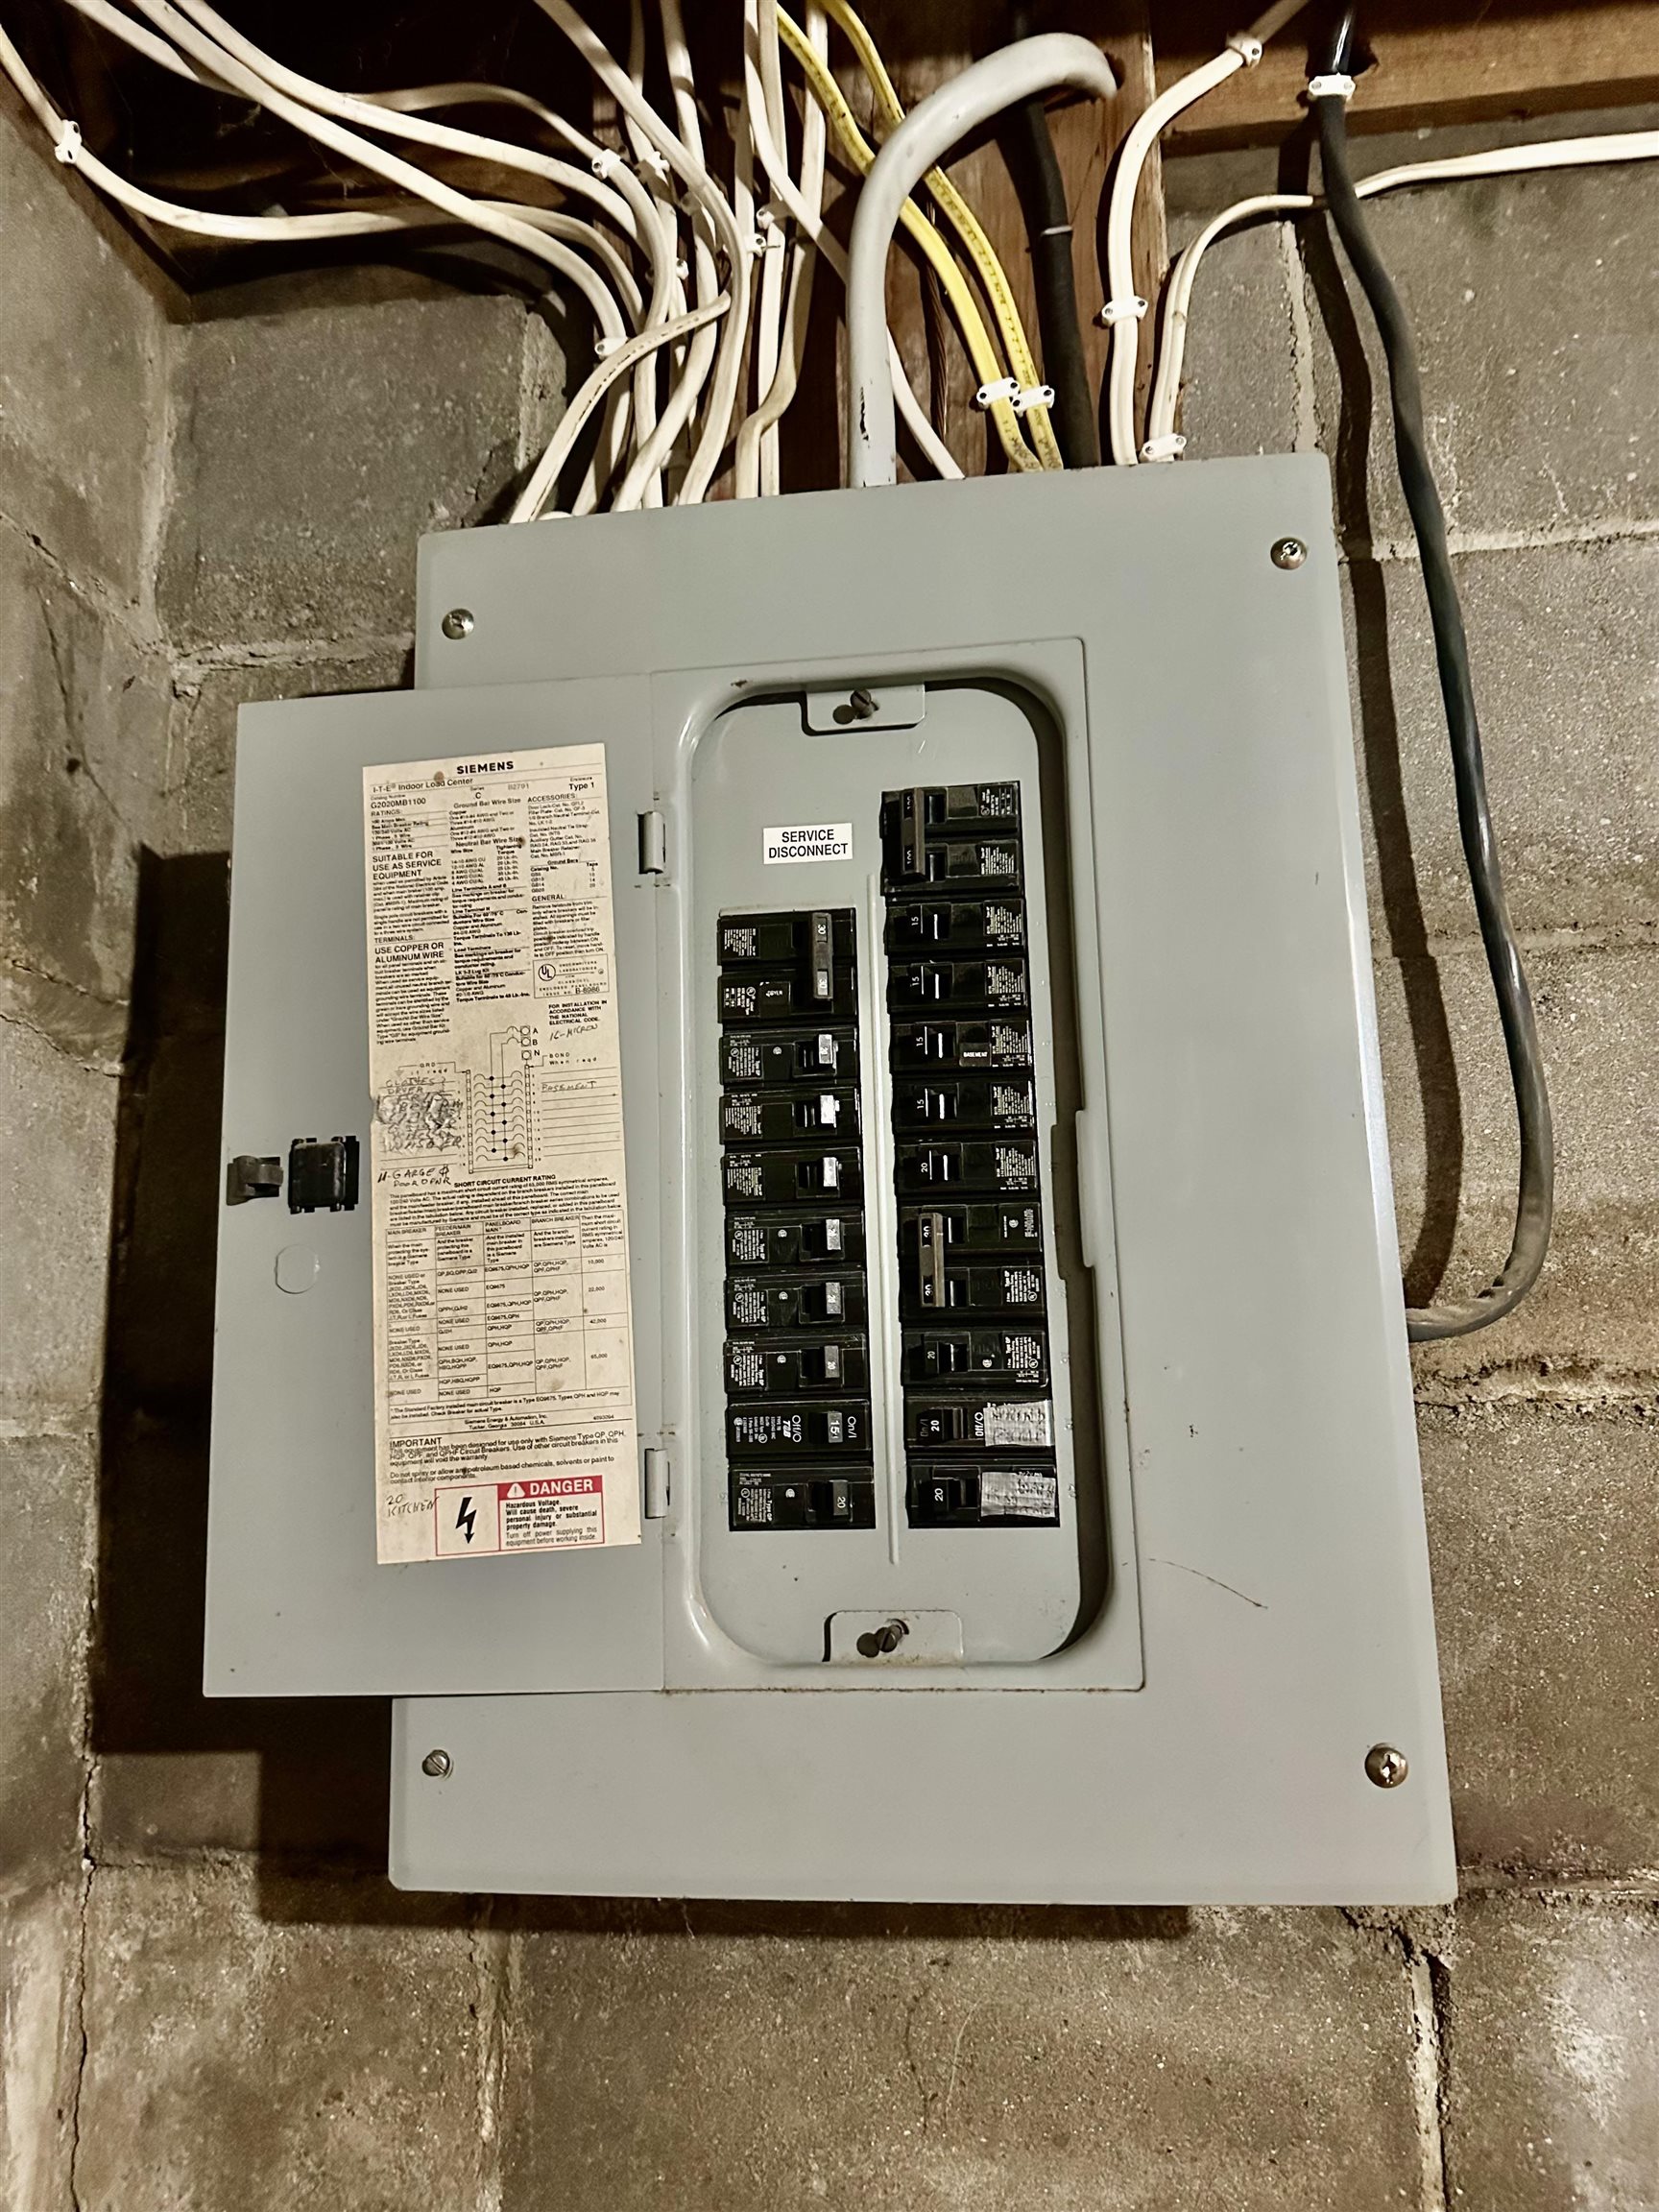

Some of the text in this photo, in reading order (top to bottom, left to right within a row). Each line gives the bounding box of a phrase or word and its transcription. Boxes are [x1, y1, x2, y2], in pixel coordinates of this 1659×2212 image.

[457, 761, 514, 774] SIEMENS
[569, 782, 588, 791] Type
[371, 798, 426, 808] G2020MB1100
[781, 830, 834, 843] SERVICE
[769, 843, 849, 858] DISCONNECT
[373, 853, 414, 863] SUITABLE
[406, 859, 442, 869] SERVICE
[373, 870, 422, 880] EQUIPMENT
[911, 916, 919, 926] 15
[817, 924, 827, 935] 30
[394, 944, 429, 953] COPPER
[375, 953, 421, 964] ALUMINUM
[818, 979, 828, 989] 30
[912, 976, 920, 987] 15
[916, 1037, 924, 1046] 15
[916, 1098, 925, 1109] 15
[921, 1163, 928, 1173] 20
[925, 1285, 933, 1296] 30
[927, 1351, 936, 1359] 20
[827, 1361, 836, 1370] 20
[792, 1414, 802, 1442] Off/O
[848, 1416, 857, 1438] On/I
[931, 1420, 940, 1431] 20
[390, 1437, 443, 1448] IMPORTANT
[500, 1460, 520, 1470] based
[530, 1479, 594, 1496] DANGER
[386, 1494, 403, 1505] 20
[934, 1488, 944, 1503] 20
[837, 1497, 847, 1509] 20
[565, 1510, 597, 1519] substantial
[557, 1527, 583, 1536] supplying
